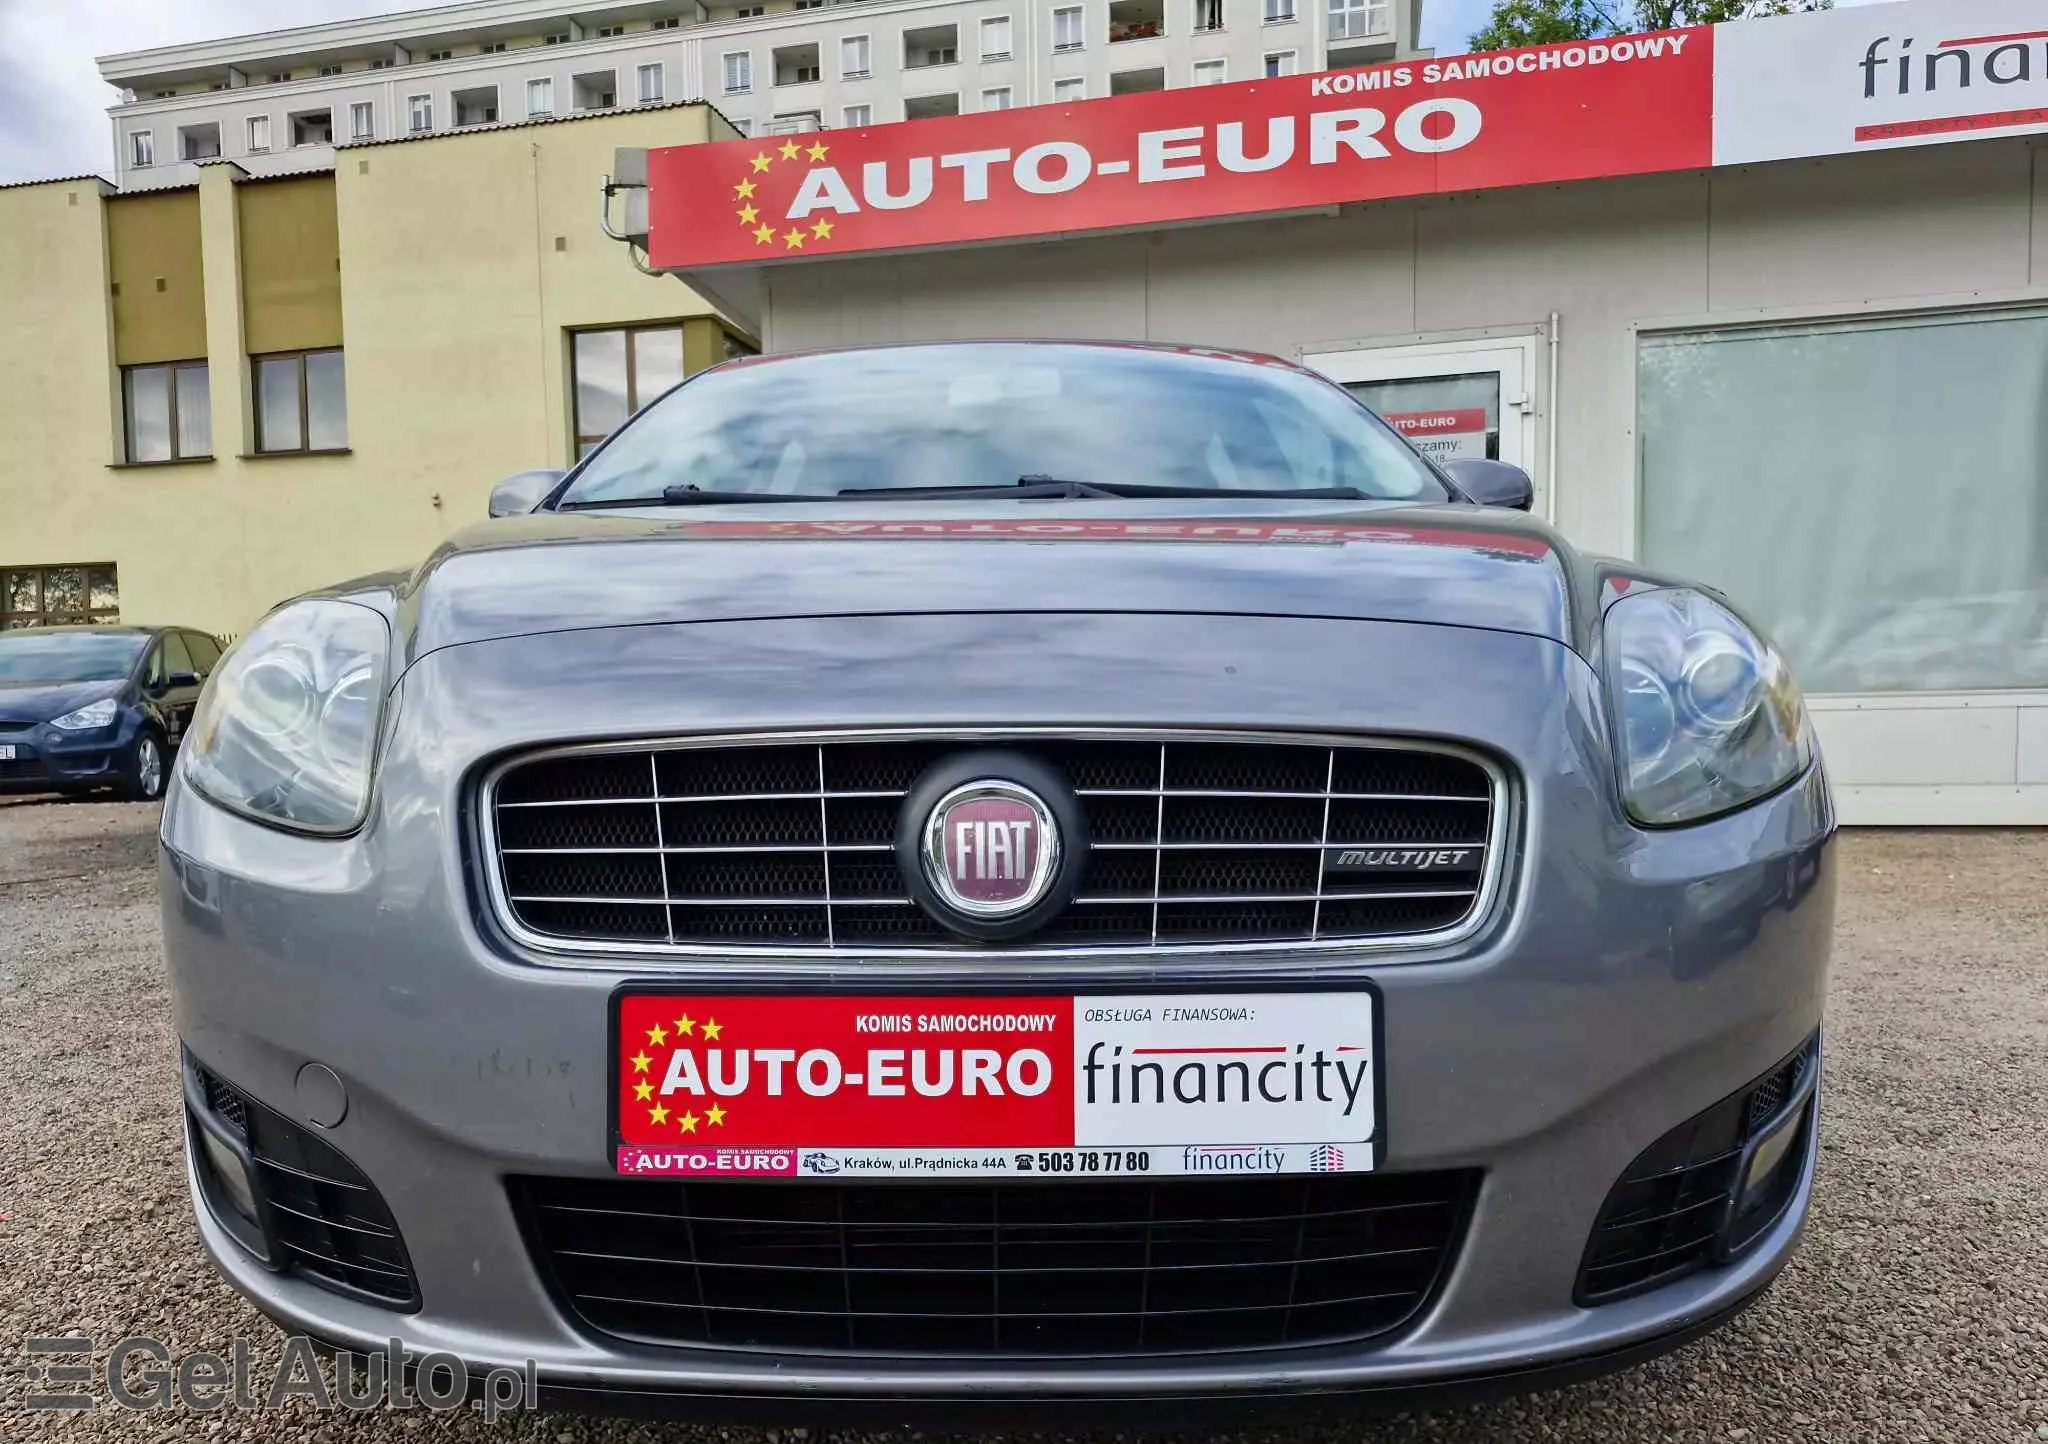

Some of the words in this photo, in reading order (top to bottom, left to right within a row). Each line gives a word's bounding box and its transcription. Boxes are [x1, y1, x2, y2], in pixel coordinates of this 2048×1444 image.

[1311, 66, 1413, 97] KOMIS
[1422, 34, 1690, 84] SAMOCHODOWY
[1859, 36, 2048, 98] fina
[785, 96, 1484, 220] AUTO-EURO
[1389, 416, 1457, 430] UTO-EURO
[956, 820, 1032, 880] FIAT
[1336, 850, 1472, 870] MULTIJET
[856, 1015, 912, 1032] KOMIS
[917, 1014, 1057, 1032] SAMOCHODOWY
[1084, 1008, 1152, 1023] OBSŁUGA
[1162, 1008, 1256, 1022] FINANSOWA:
[659, 1048, 1052, 1097] AUTO-EURO
[1083, 1041, 1368, 1116] financity
[635, 1154, 790, 1170] AUTO-EURO
[844, 1157, 895, 1170] Kraków,
[982, 1157, 1007, 1169] 44A
[1038, 1152, 1075, 1172] 503
[1078, 1152, 1100, 1172] 78
[1103, 1152, 1123, 1172] 77
[1125, 1151, 1150, 1172] 80
[1182, 1145, 1285, 1174] financity
